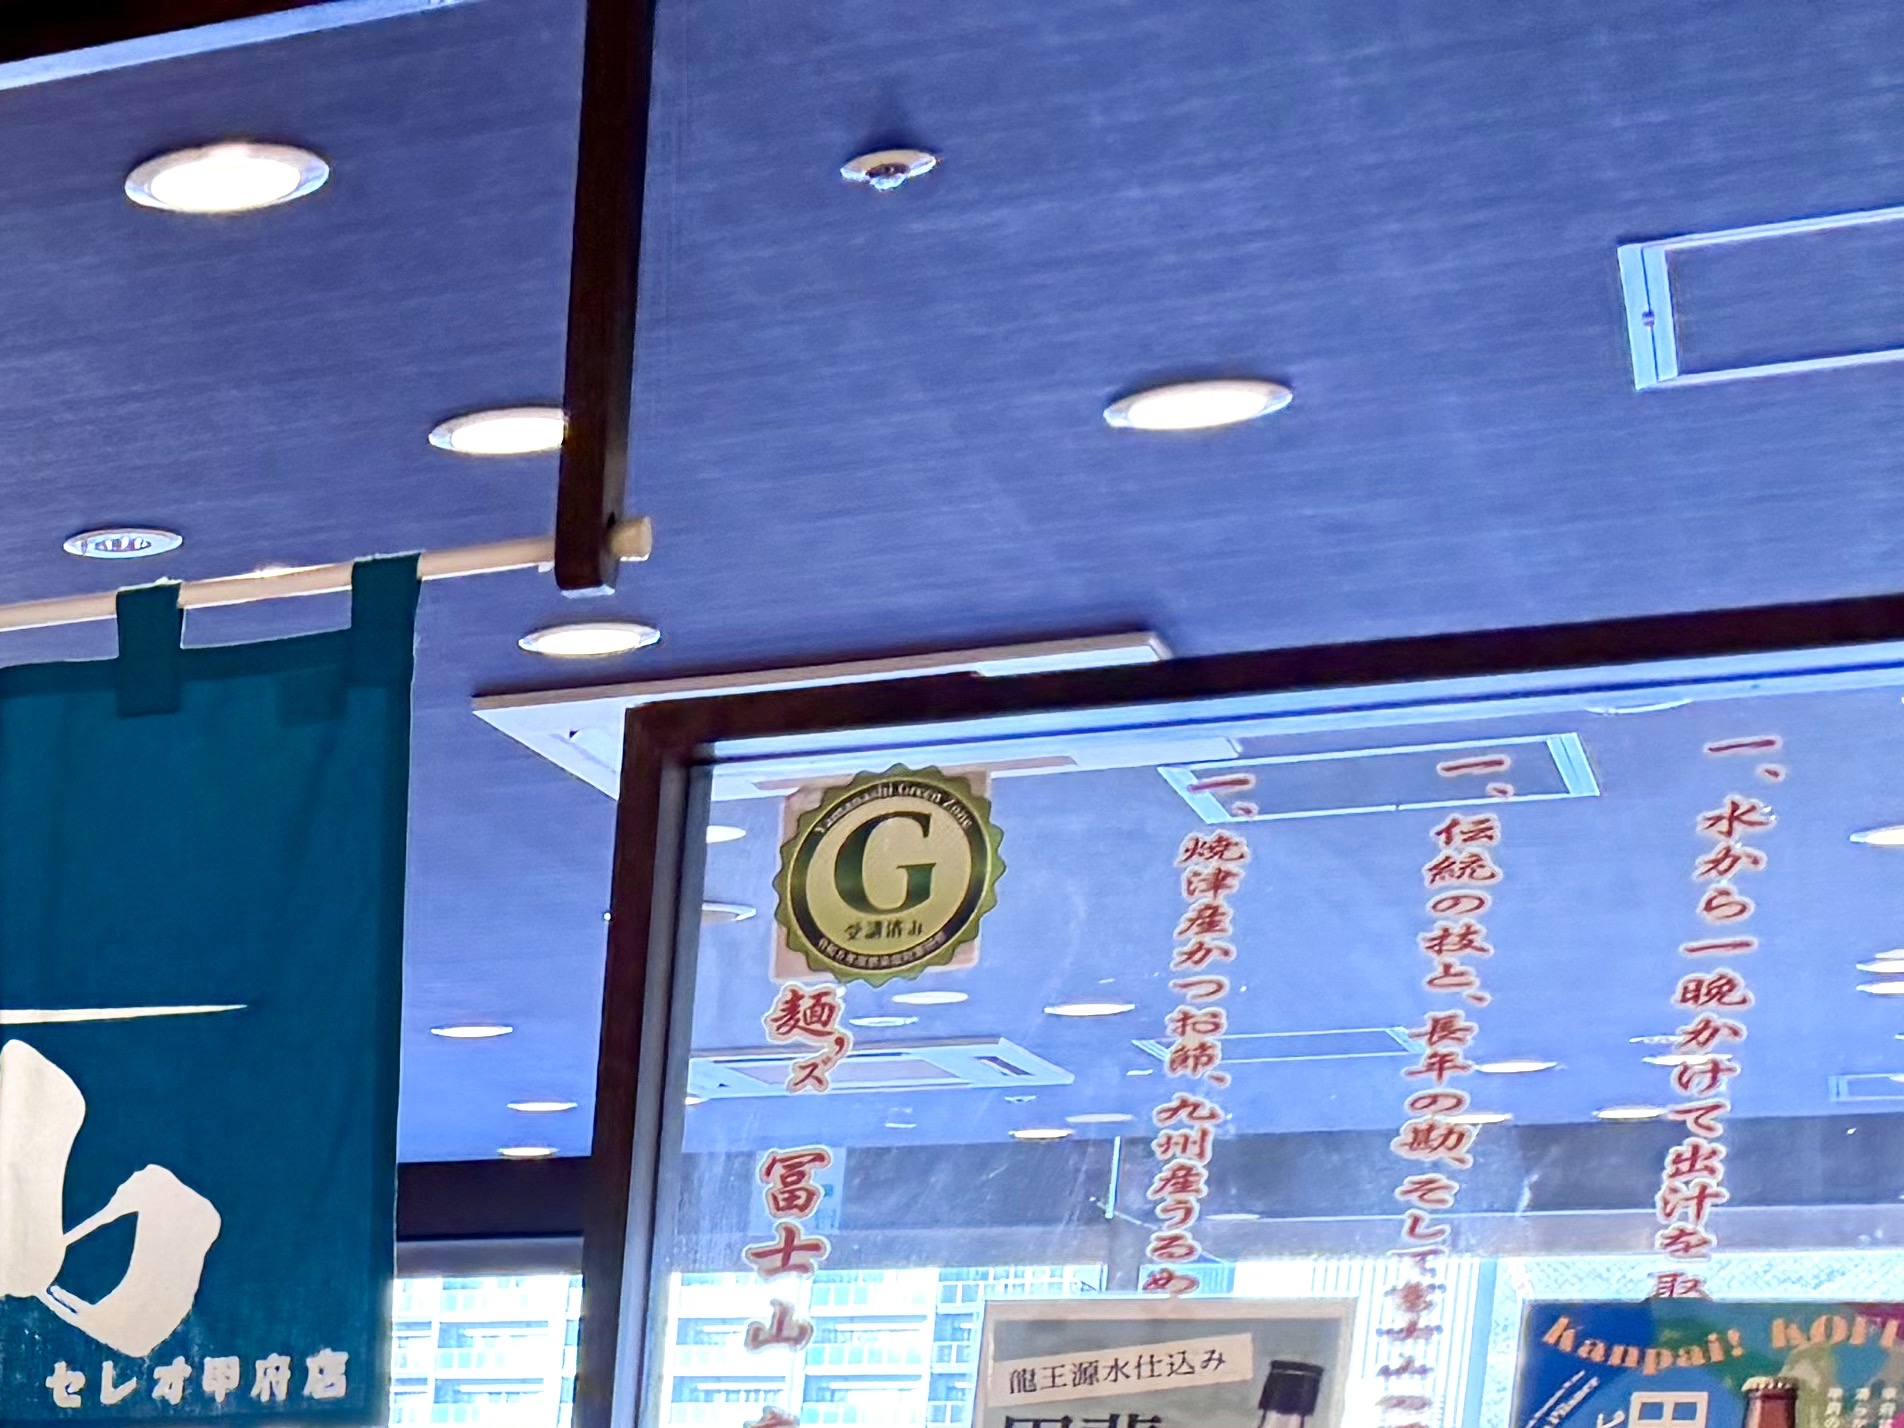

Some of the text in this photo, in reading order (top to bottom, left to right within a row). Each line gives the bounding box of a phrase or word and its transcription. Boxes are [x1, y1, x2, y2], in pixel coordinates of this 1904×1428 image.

[897, 783, 941, 803] Green
[942, 797, 974, 830] Zone
[834, 810, 937, 916] G
[1541, 1314, 1745, 1376] Kanpai!
[45, 1349, 349, 1408] セレオ甲府店
